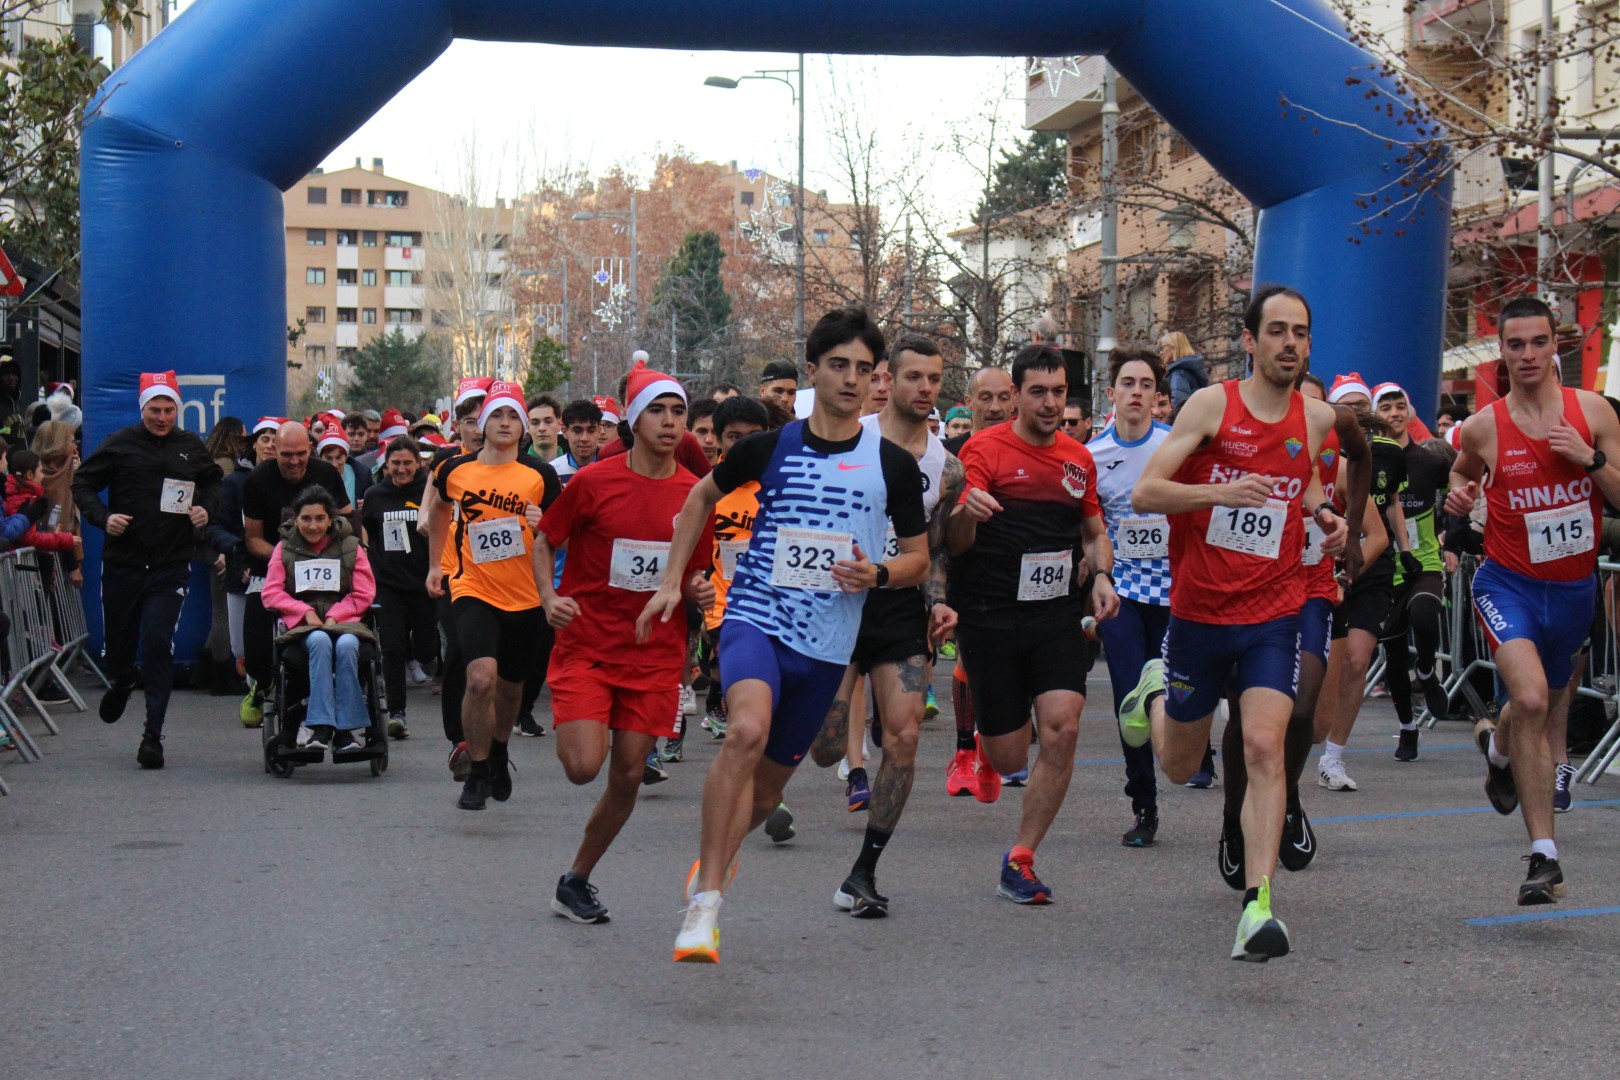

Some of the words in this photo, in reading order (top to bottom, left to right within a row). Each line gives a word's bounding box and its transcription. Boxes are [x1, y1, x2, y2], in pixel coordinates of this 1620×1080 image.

[178, 388, 226, 434] nf
[1221, 440, 1258, 453] Huesca
[1502, 461, 1537, 473] Huesca
[176, 489, 185, 503] 2
[1507, 476, 1593, 510] HINACO
[383, 510, 418, 521] PUMA
[1227, 508, 1272, 538] 189
[477, 530, 513, 550] 268
[1127, 528, 1162, 545] 326
[1541, 518, 1583, 545] 115
[631, 555, 659, 576] 34
[786, 545, 836, 572] 323
[303, 567, 332, 581] 178
[1030, 565, 1064, 585] 484
